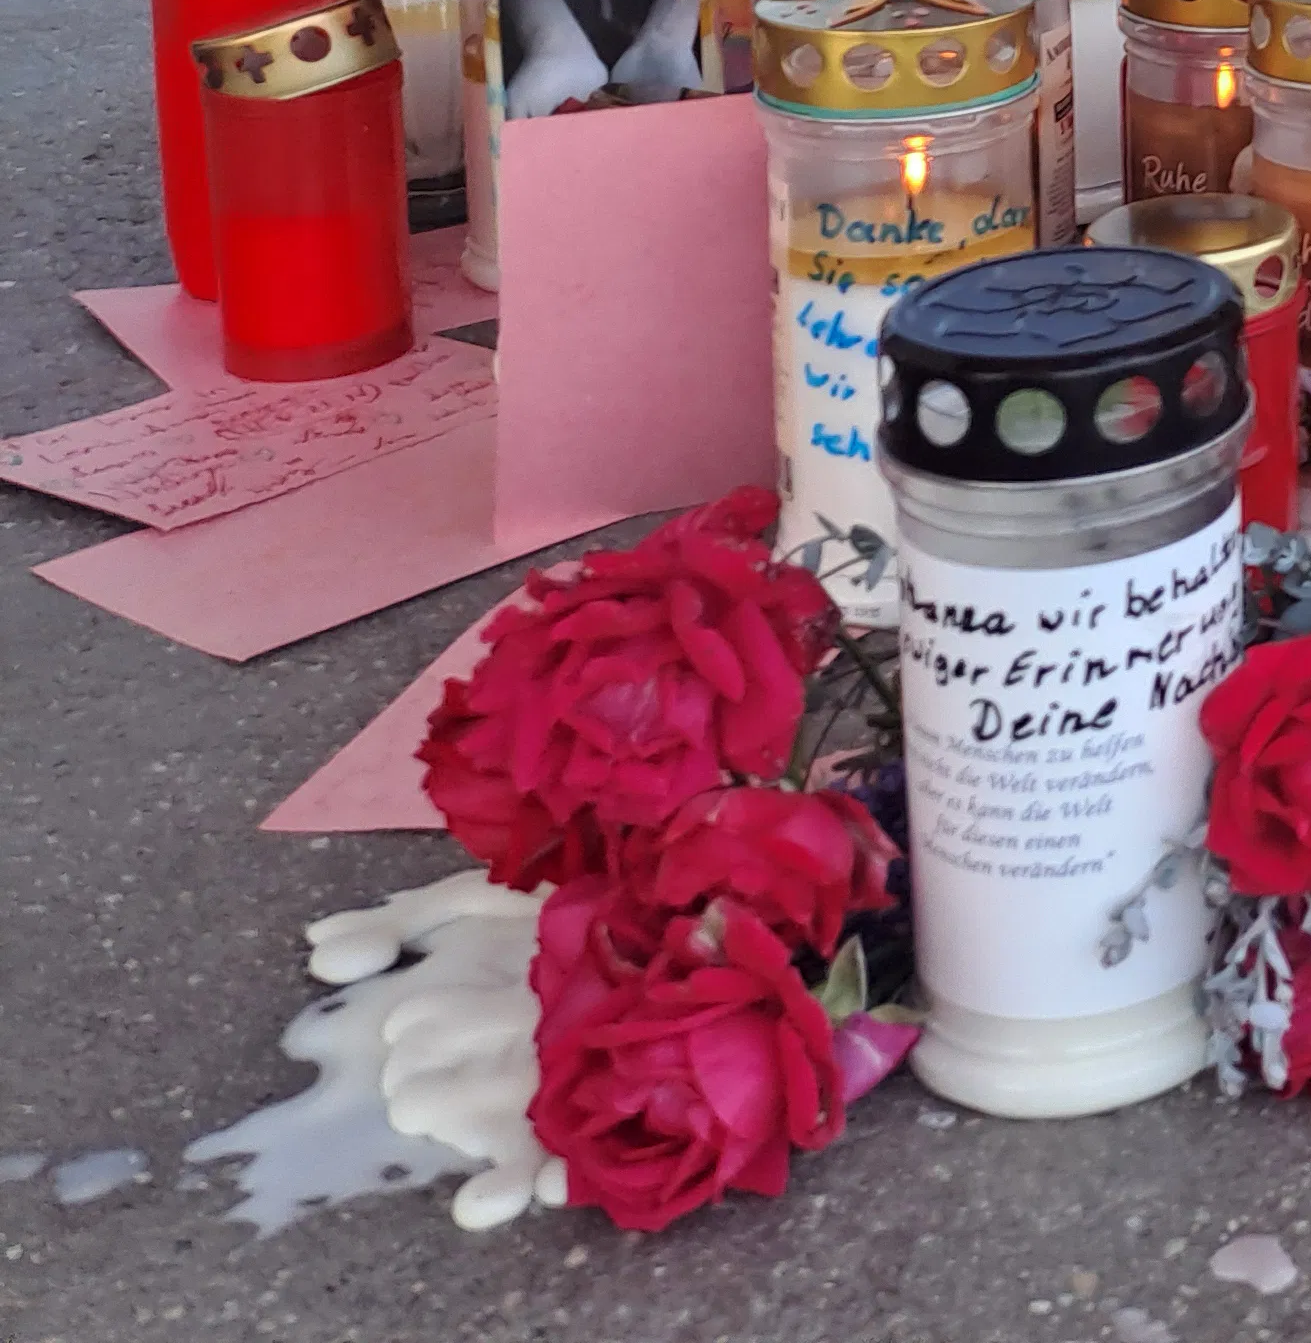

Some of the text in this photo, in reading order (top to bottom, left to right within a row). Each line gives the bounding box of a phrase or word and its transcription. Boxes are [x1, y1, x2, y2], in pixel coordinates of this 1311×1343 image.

[1142, 155, 1208, 193] Ruhe
[1038, 588, 1106, 630] wir
[969, 698, 1118, 742] Deine
[1046, 747, 1074, 764] zu
[1080, 731, 1146, 763] helfen
[988, 771, 1037, 793] Welt
[1061, 792, 1114, 818] Welt
[1024, 833, 1082, 850] einen
